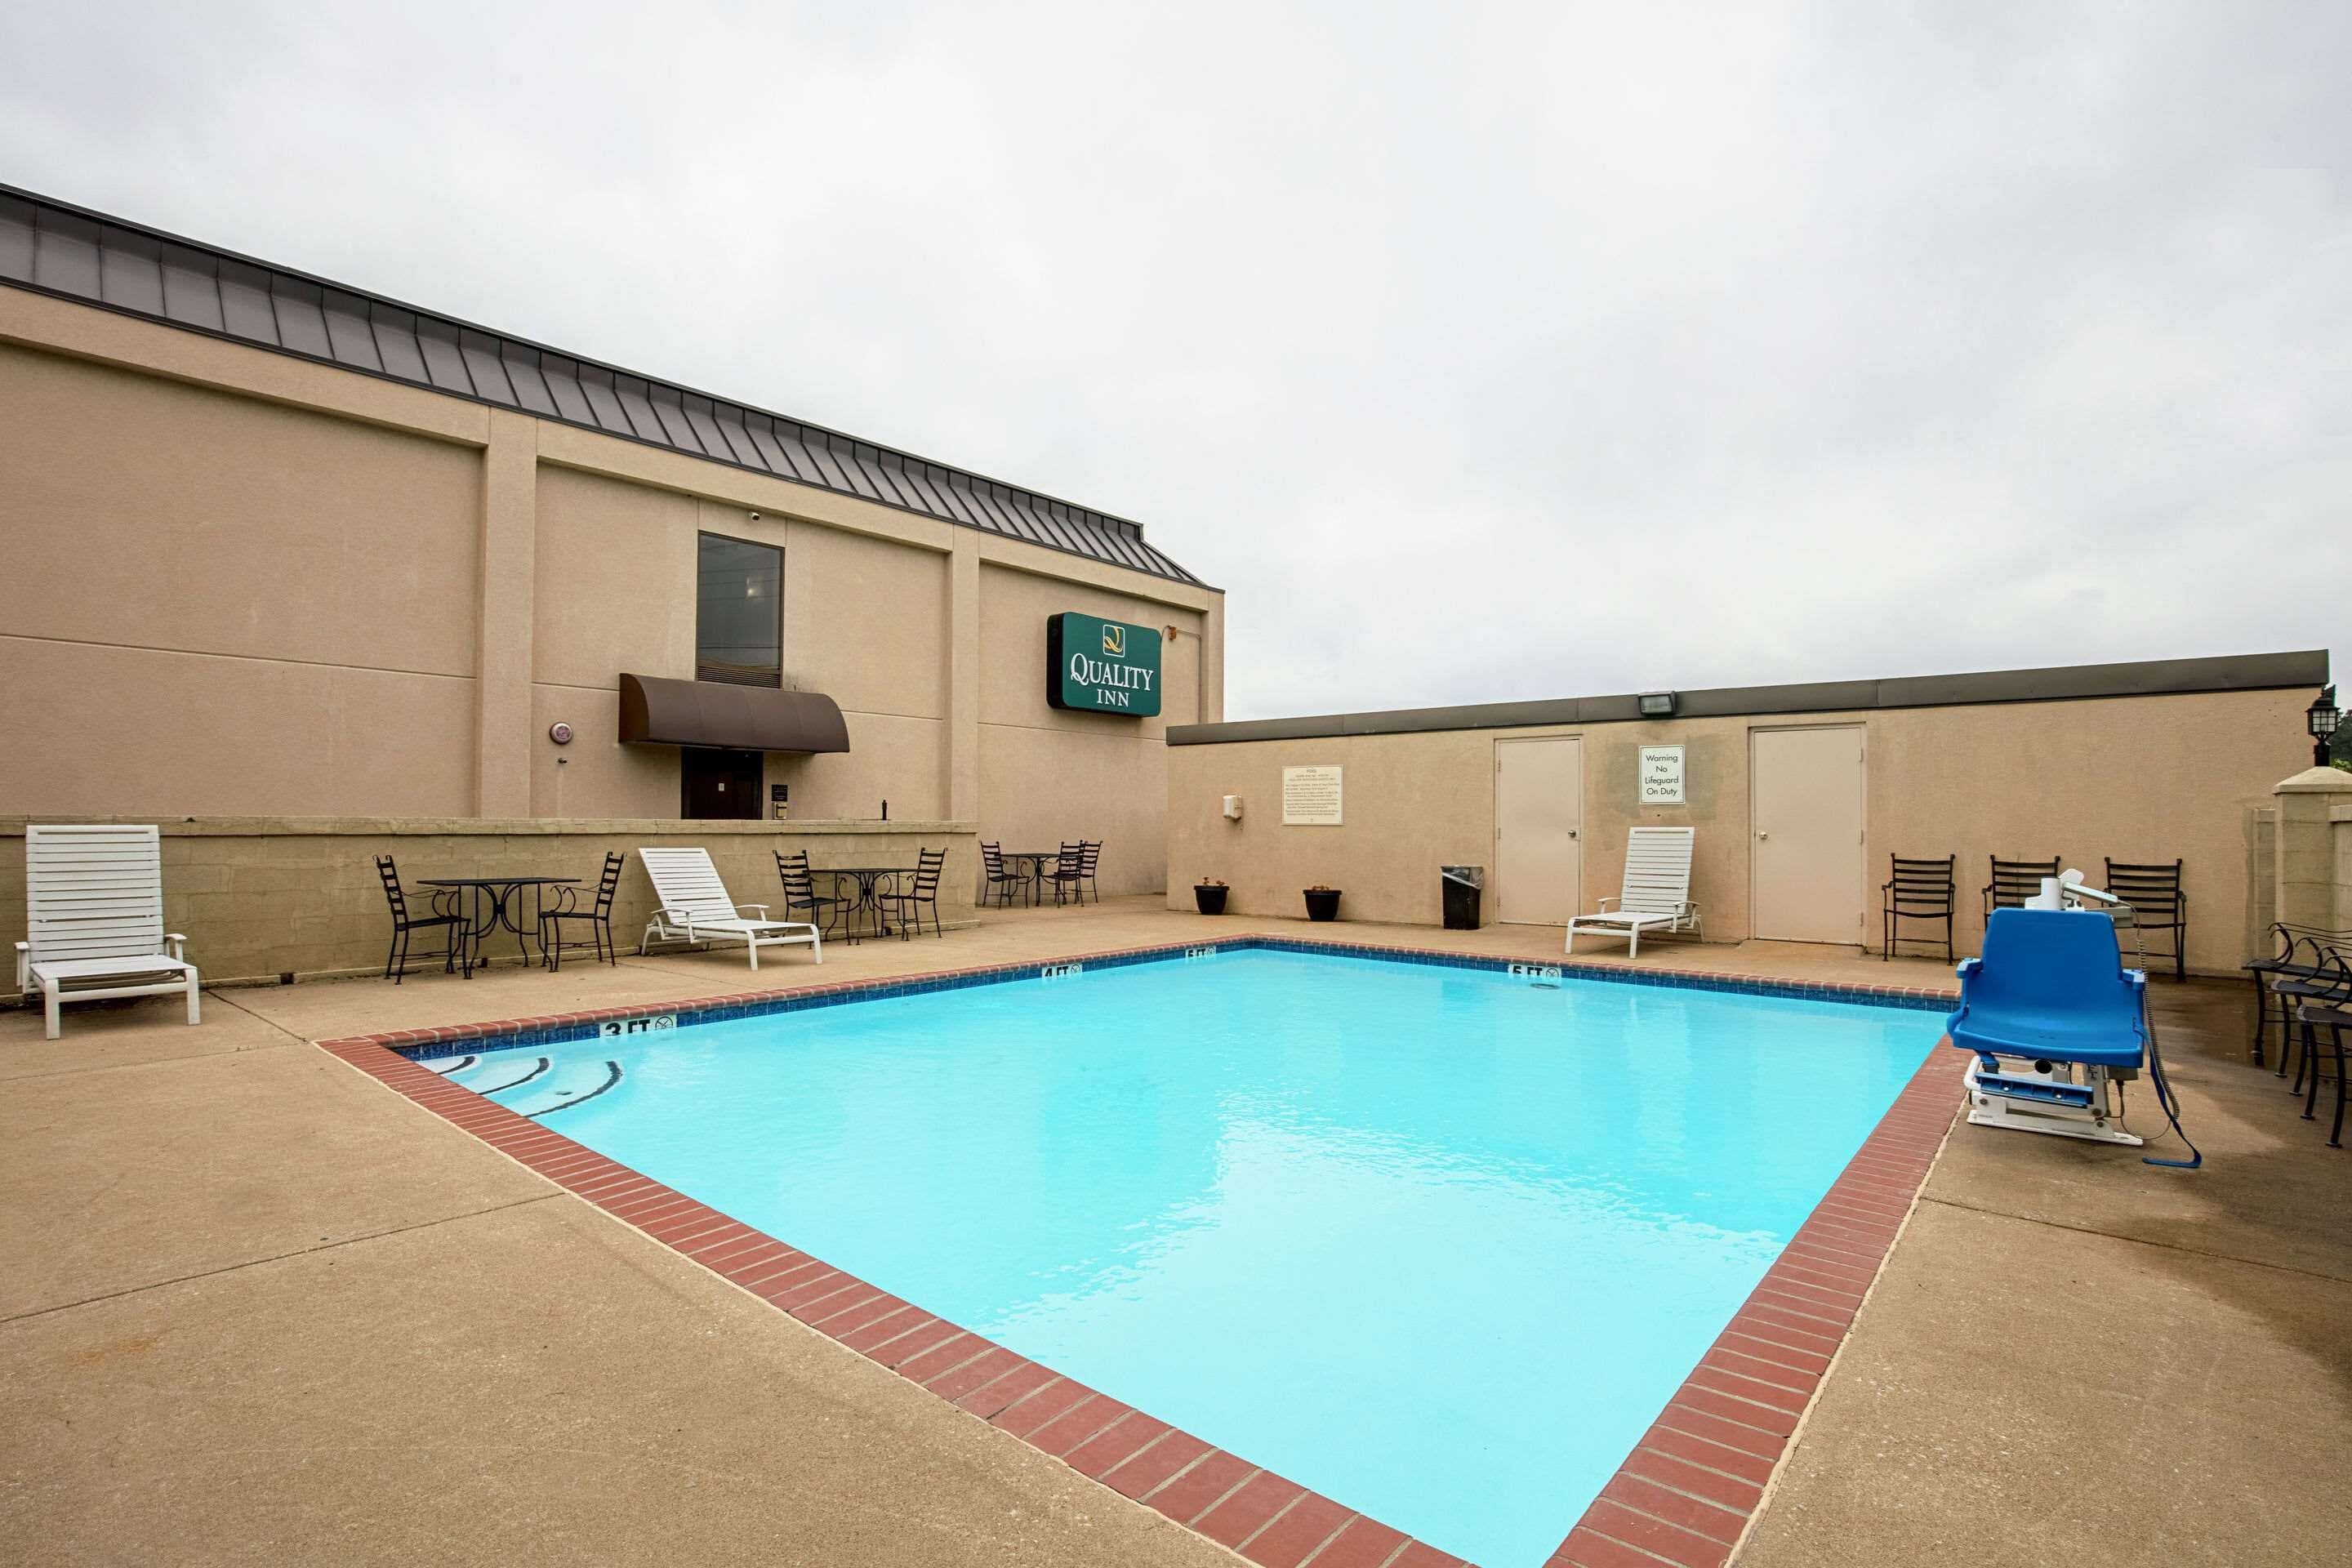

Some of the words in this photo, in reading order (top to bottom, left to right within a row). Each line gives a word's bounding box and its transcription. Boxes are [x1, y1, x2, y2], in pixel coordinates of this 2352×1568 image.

[1071, 653, 1154, 691] QUALITY
[1097, 688, 1129, 707] INN
[1646, 754, 1678, 764] Warning
[1645, 775, 1679, 786] Lifeguard
[1646, 787, 1659, 795] On
[1660, 787, 1678, 797] Duty
[1056, 965, 1069, 976] FT
[1512, 965, 1521, 973] 5
[1526, 966, 1543, 976] FT
[605, 1022, 621, 1036] 3
[627, 1018, 651, 1034] FT
